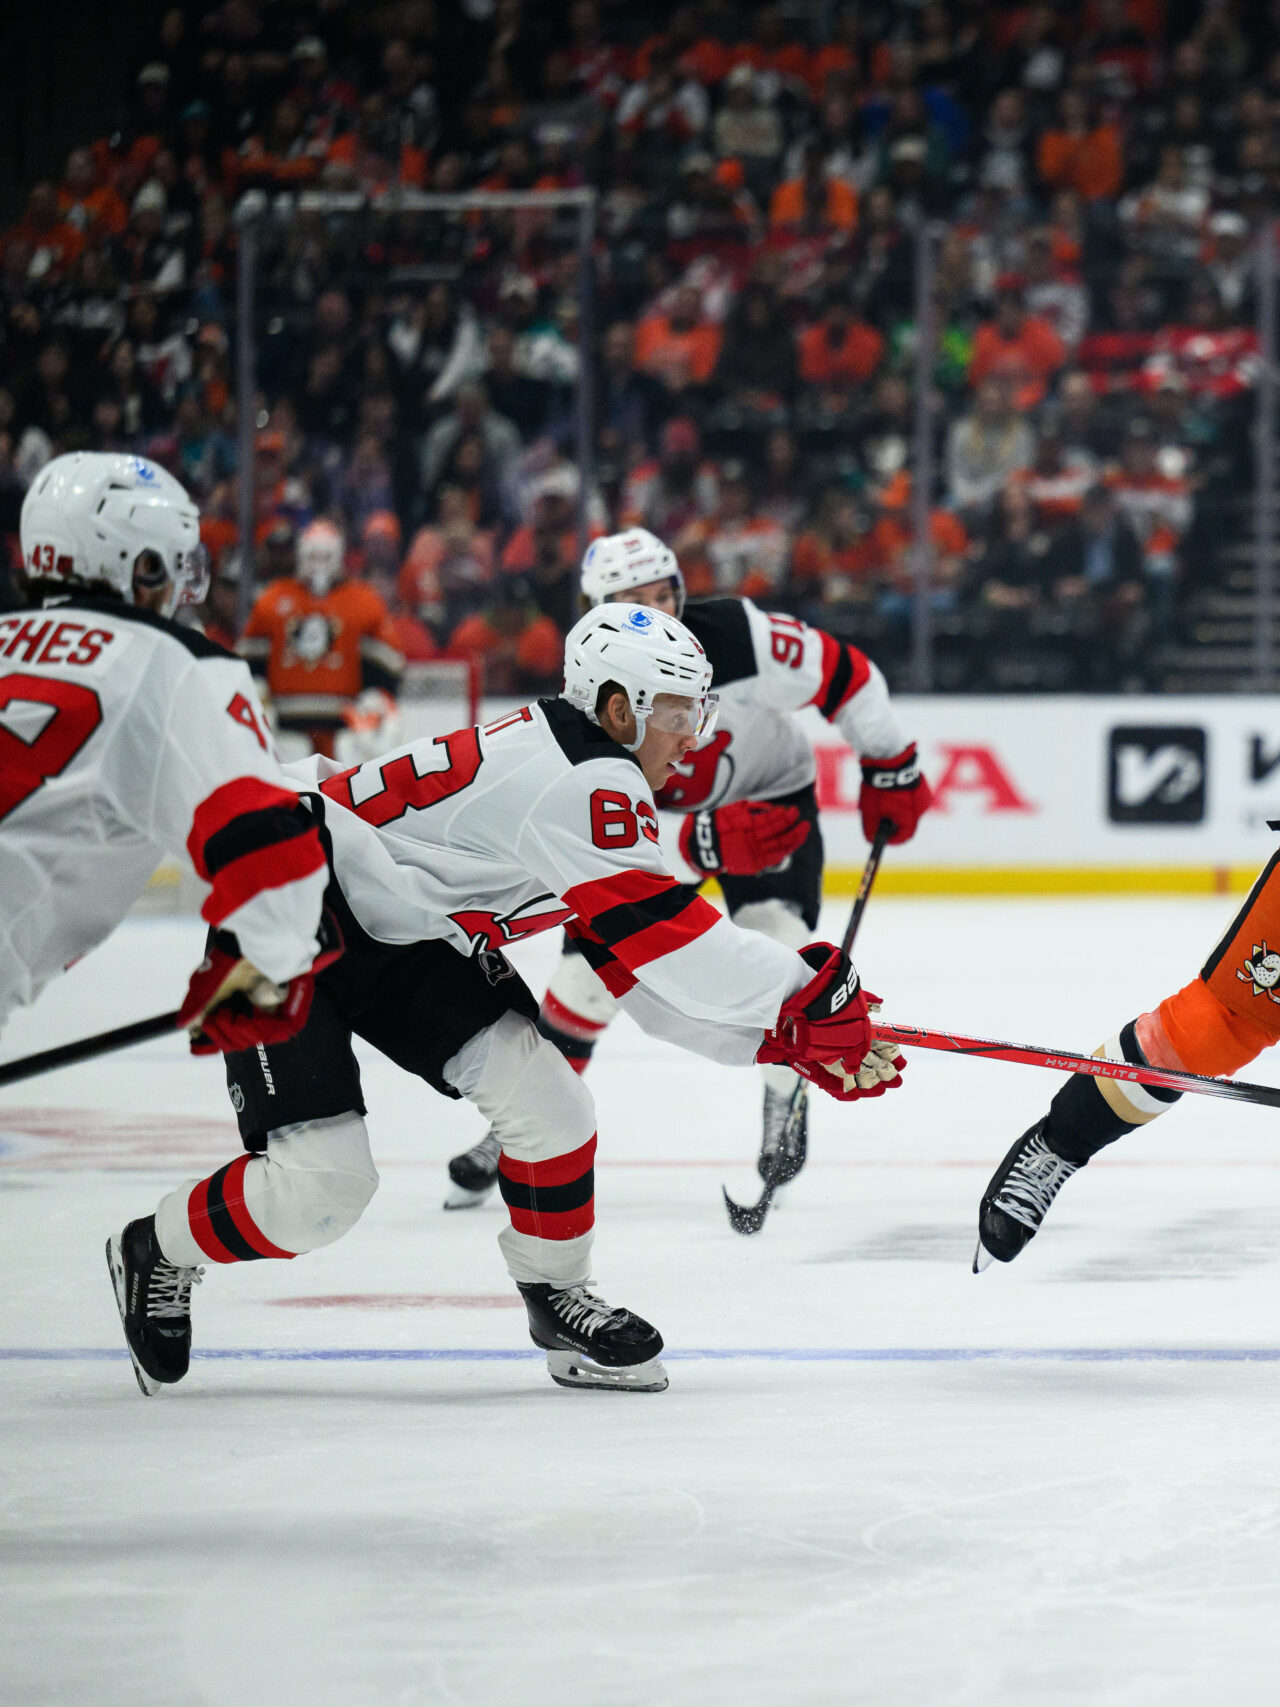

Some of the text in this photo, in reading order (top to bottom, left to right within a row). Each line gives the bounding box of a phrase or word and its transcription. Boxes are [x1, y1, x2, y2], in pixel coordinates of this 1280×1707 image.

[32, 545, 55, 572] 43
[871, 764, 922, 788] CC
[590, 788, 660, 850] 63
[256, 1041, 276, 1096] BAUER
[556, 1332, 589, 1353] BAUER
